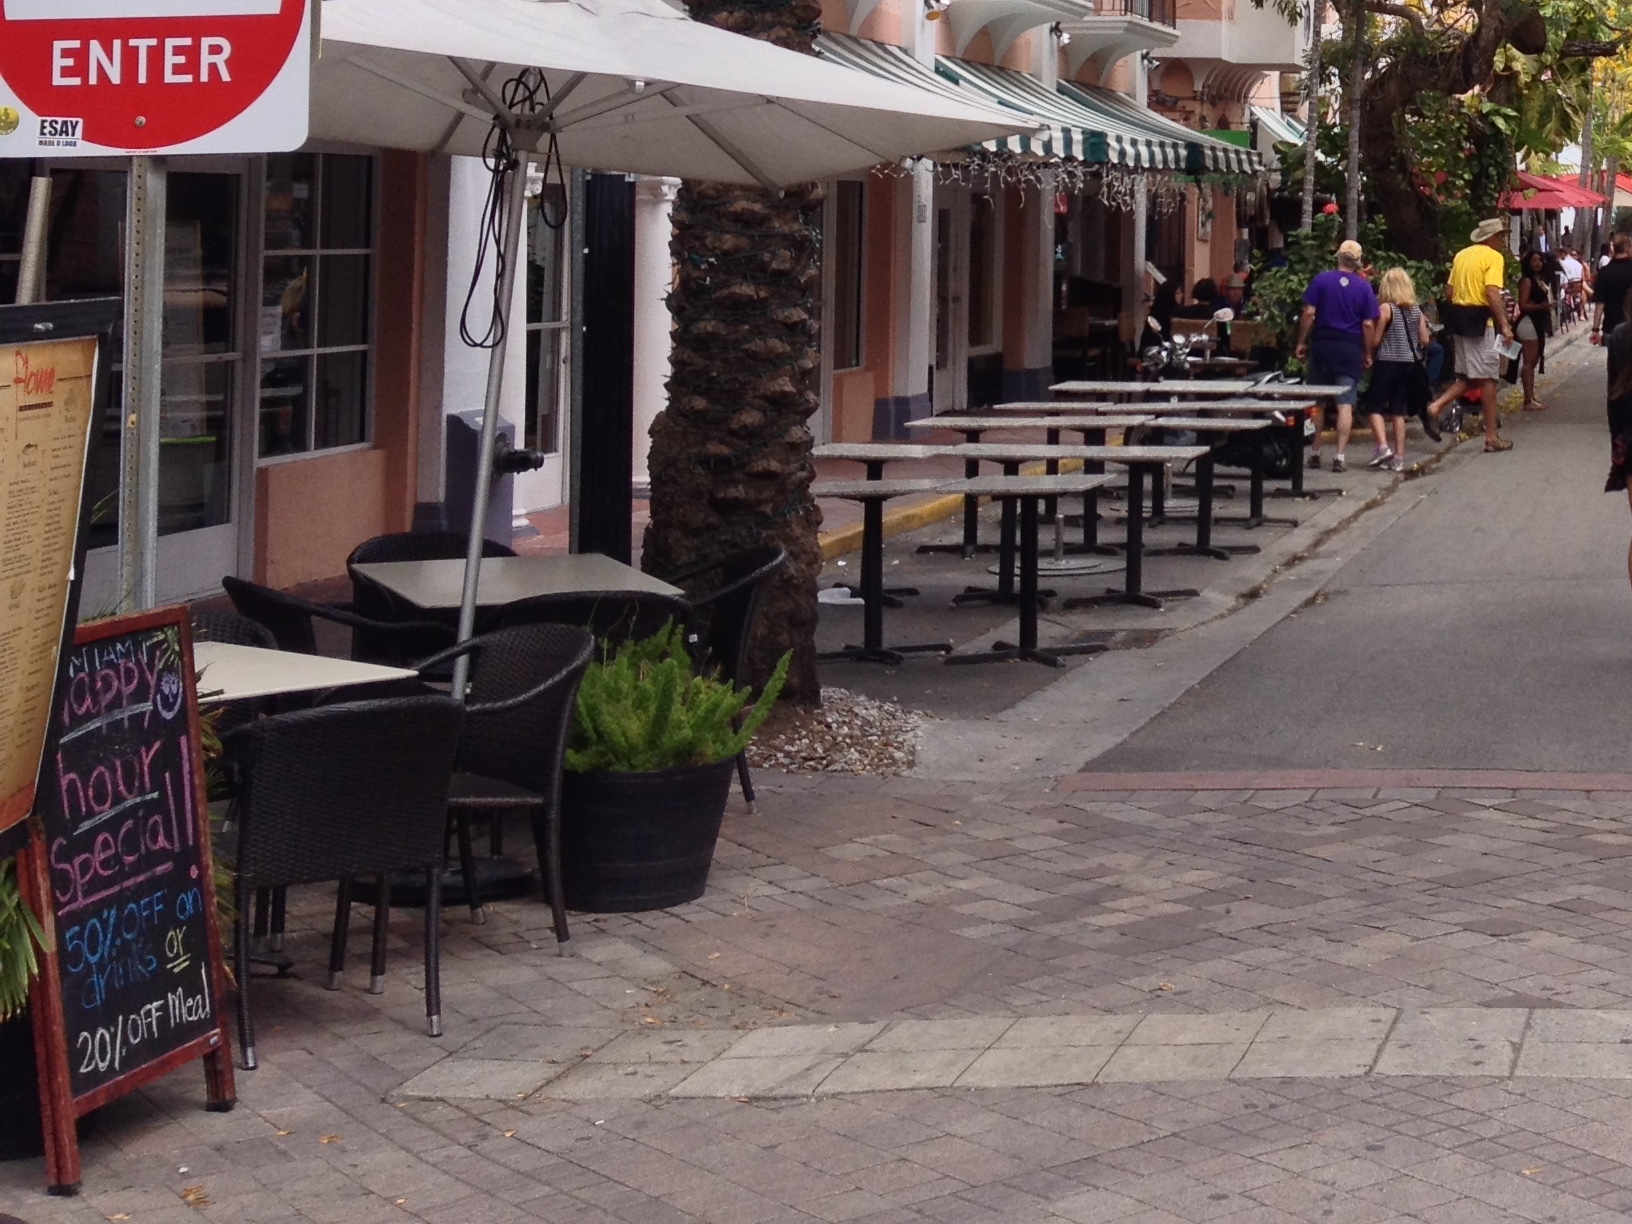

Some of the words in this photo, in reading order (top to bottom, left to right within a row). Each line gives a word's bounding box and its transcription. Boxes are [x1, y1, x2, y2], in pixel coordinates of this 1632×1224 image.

[51, 38, 232, 86] ENTER
[39, 119, 80, 137] ESAY
[64, 650, 161, 734] appy
[69, 639, 148, 678] MIAMI
[57, 739, 163, 819] hour
[65, 905, 121, 972] 50%
[122, 890, 165, 941] OFF
[176, 887, 203, 921] on
[82, 941, 157, 1009] drinks
[165, 926, 187, 957] or
[77, 1015, 126, 1073] 20%
[128, 999, 165, 1045] OFF
[168, 962, 211, 1029] Meal
